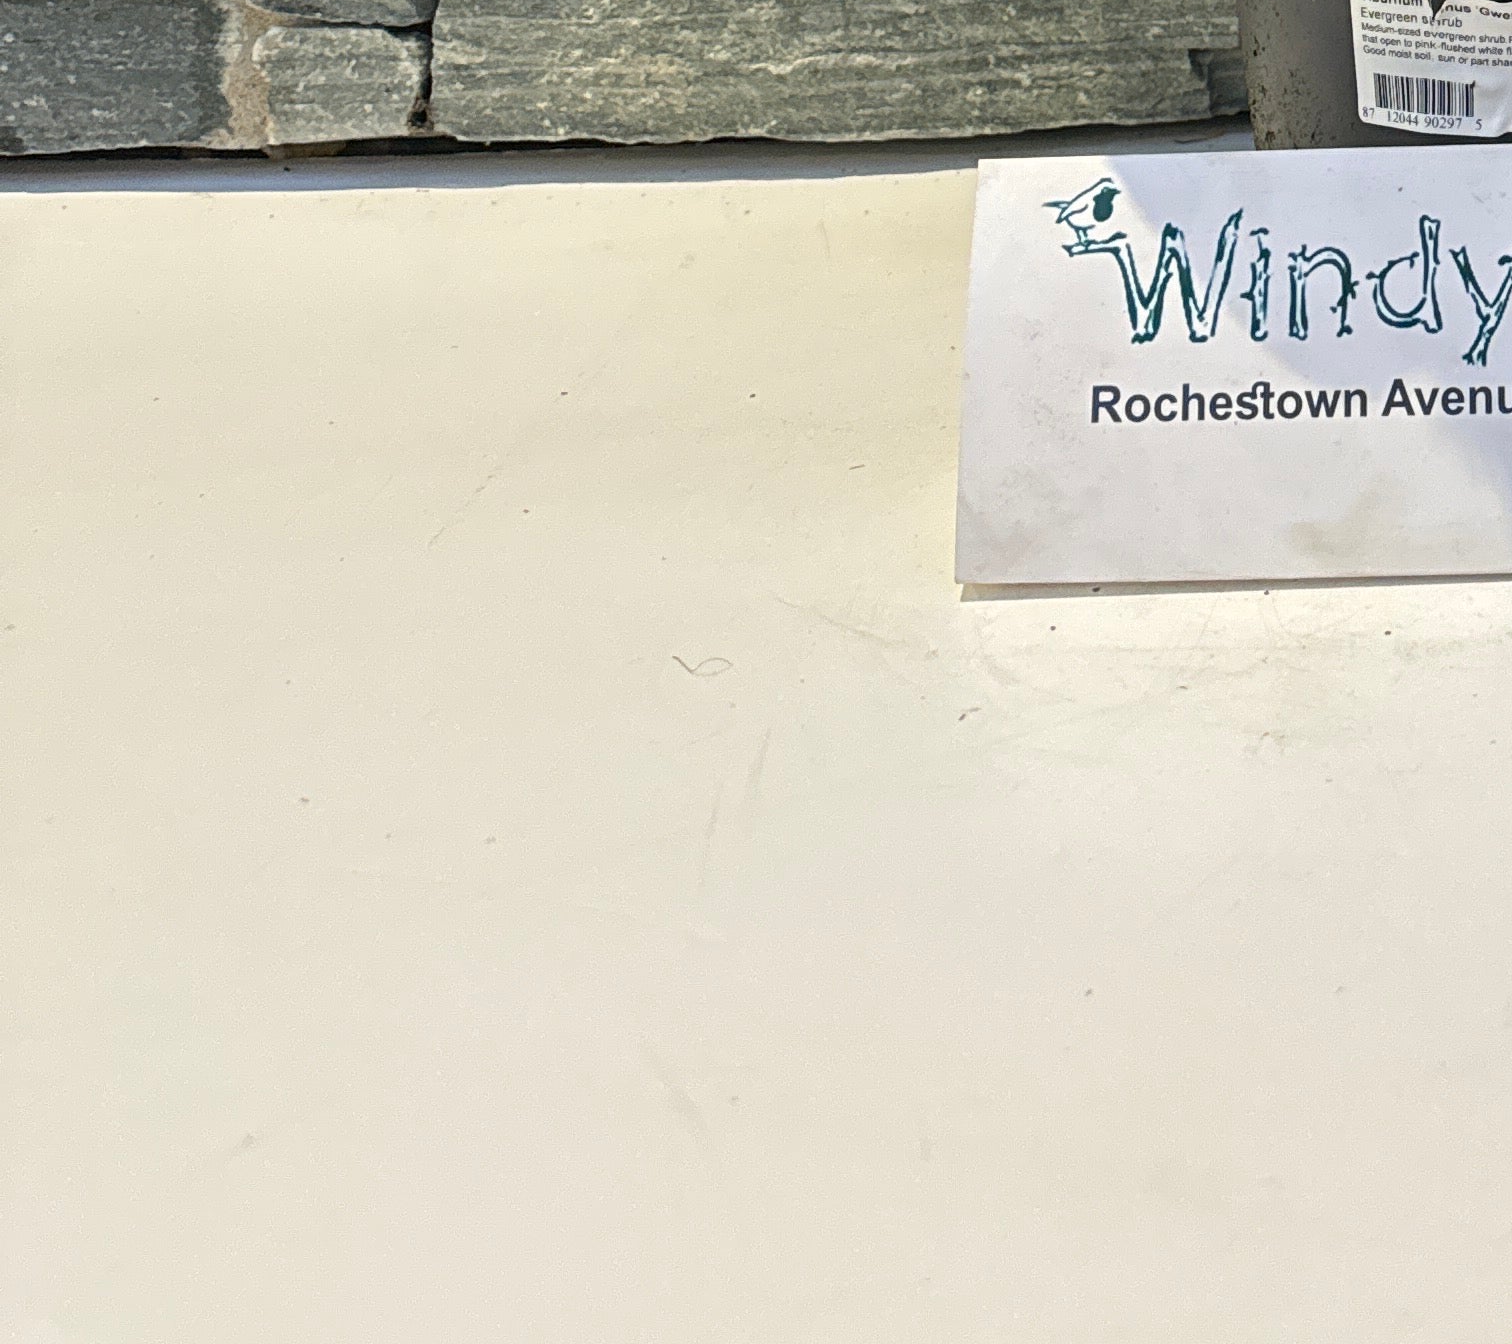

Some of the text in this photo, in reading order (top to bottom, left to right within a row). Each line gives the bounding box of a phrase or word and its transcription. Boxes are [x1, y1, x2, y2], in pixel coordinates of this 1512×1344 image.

[1360, 7, 1418, 25] Evergreen
[1361, 22, 1421, 37] Medium-sized
[1424, 30, 1477, 43] evergreen
[1362, 34, 1378, 44] that
[1380, 36, 1401, 49] open
[1403, 39, 1412, 47] to
[1478, 45, 1503, 56] white
[1362, 44, 1386, 57] Good
[1388, 49, 1412, 60] moist
[1438, 54, 1456, 63] sun
[1458, 55, 1469, 64] or
[1470, 57, 1489, 68] part
[1362, 107, 1483, 131] 87 12044 90297 5
[1090, 381, 1367, 423] Rochestown
